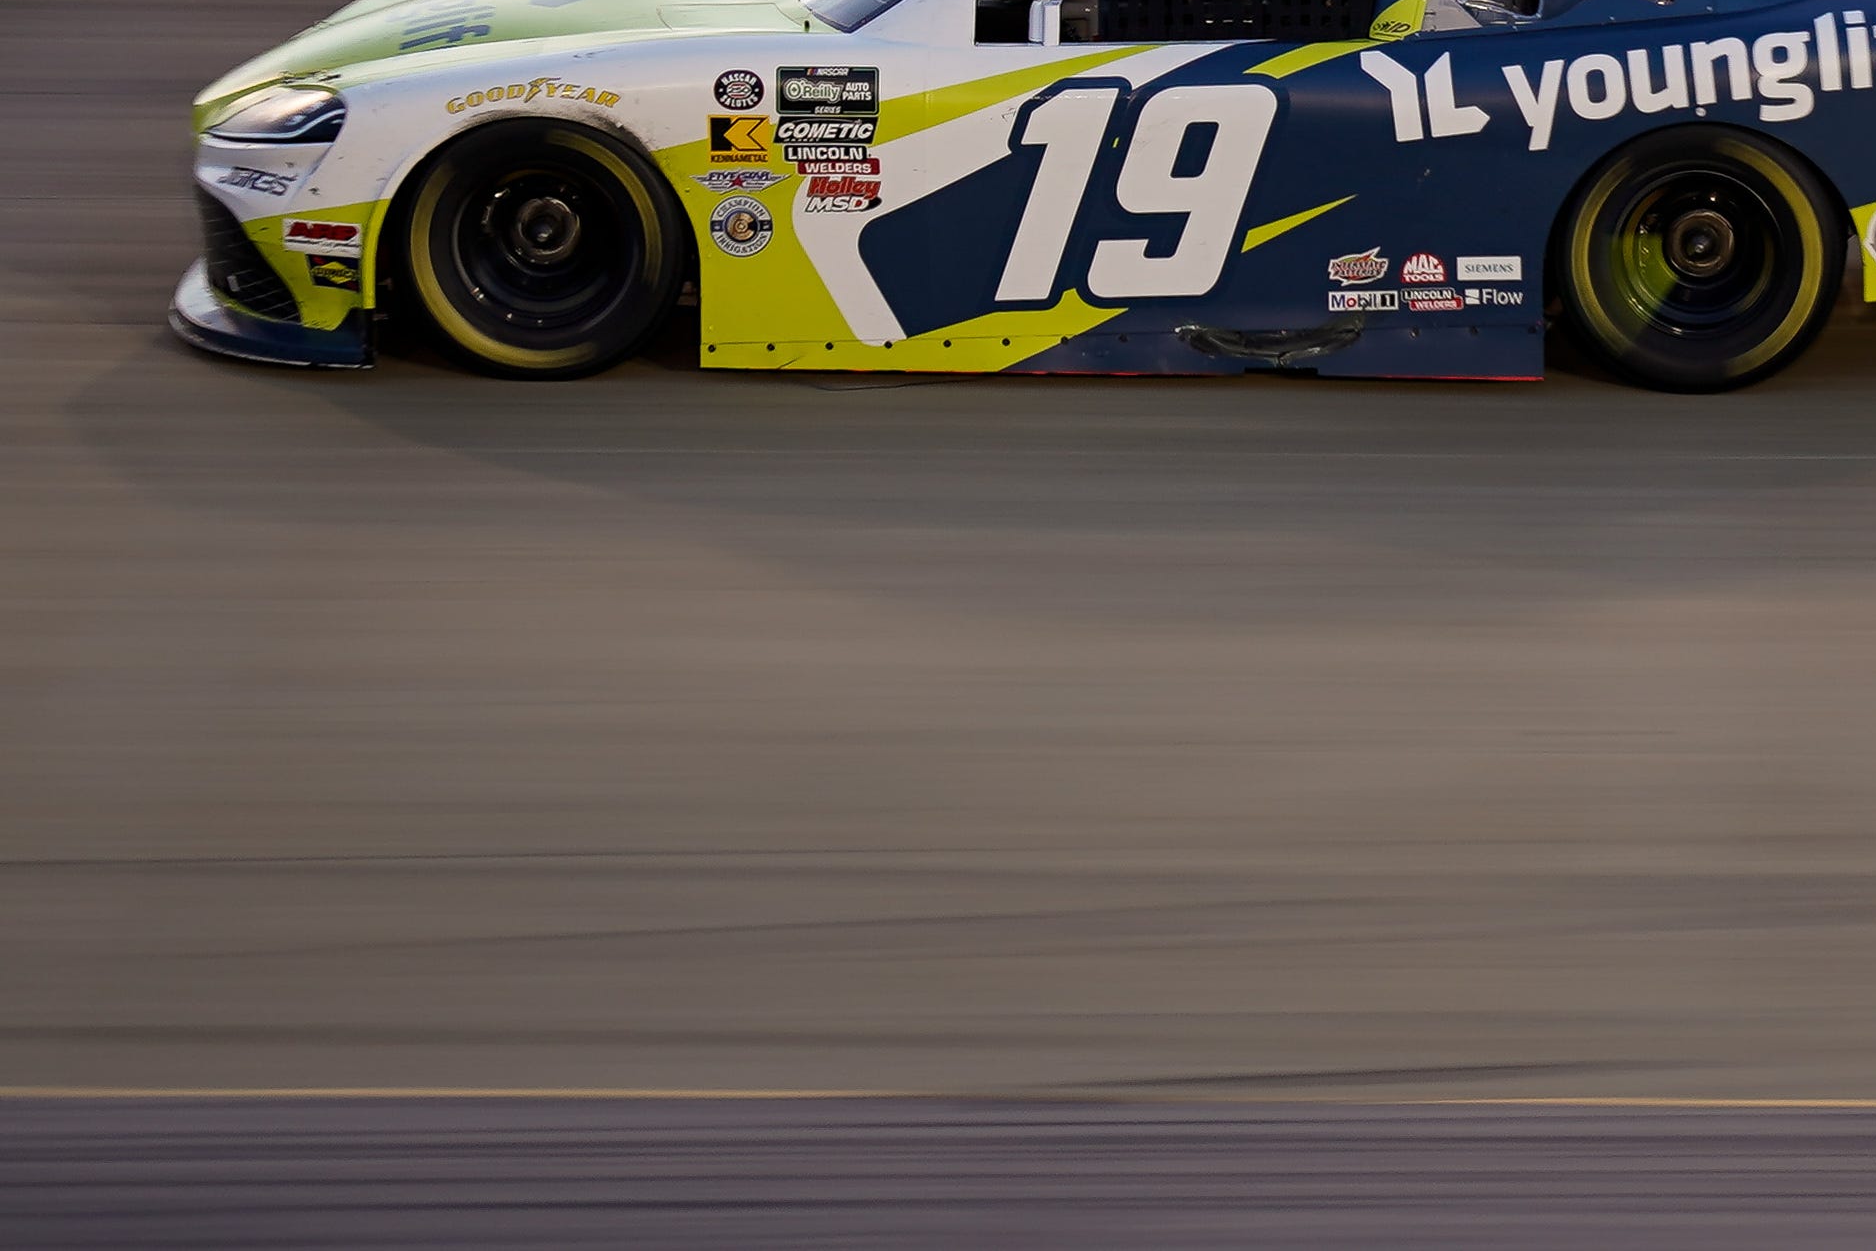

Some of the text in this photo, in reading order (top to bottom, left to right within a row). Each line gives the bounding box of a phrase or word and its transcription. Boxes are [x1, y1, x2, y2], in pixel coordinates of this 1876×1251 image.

[845, 82, 870, 92] AUTO
[842, 91, 872, 101] PARTS
[777, 121, 874, 139] COMETIC
[787, 147, 864, 160] LINCOLN
[804, 163, 872, 174] WELDERS
[806, 176, 882, 199] Holley
[994, 84, 1279, 302] 19
[716, 196, 767, 219] CHAMPION
[805, 197, 870, 213] MSD
[1403, 253, 1443, 274] MAC
[1464, 263, 1514, 274] SIEMENS
[1403, 273, 1445, 282] TOOLS
[1403, 290, 1453, 299] LINCOLN
[1481, 288, 1524, 305] Flow
[1414, 300, 1459, 310] WELDERS
